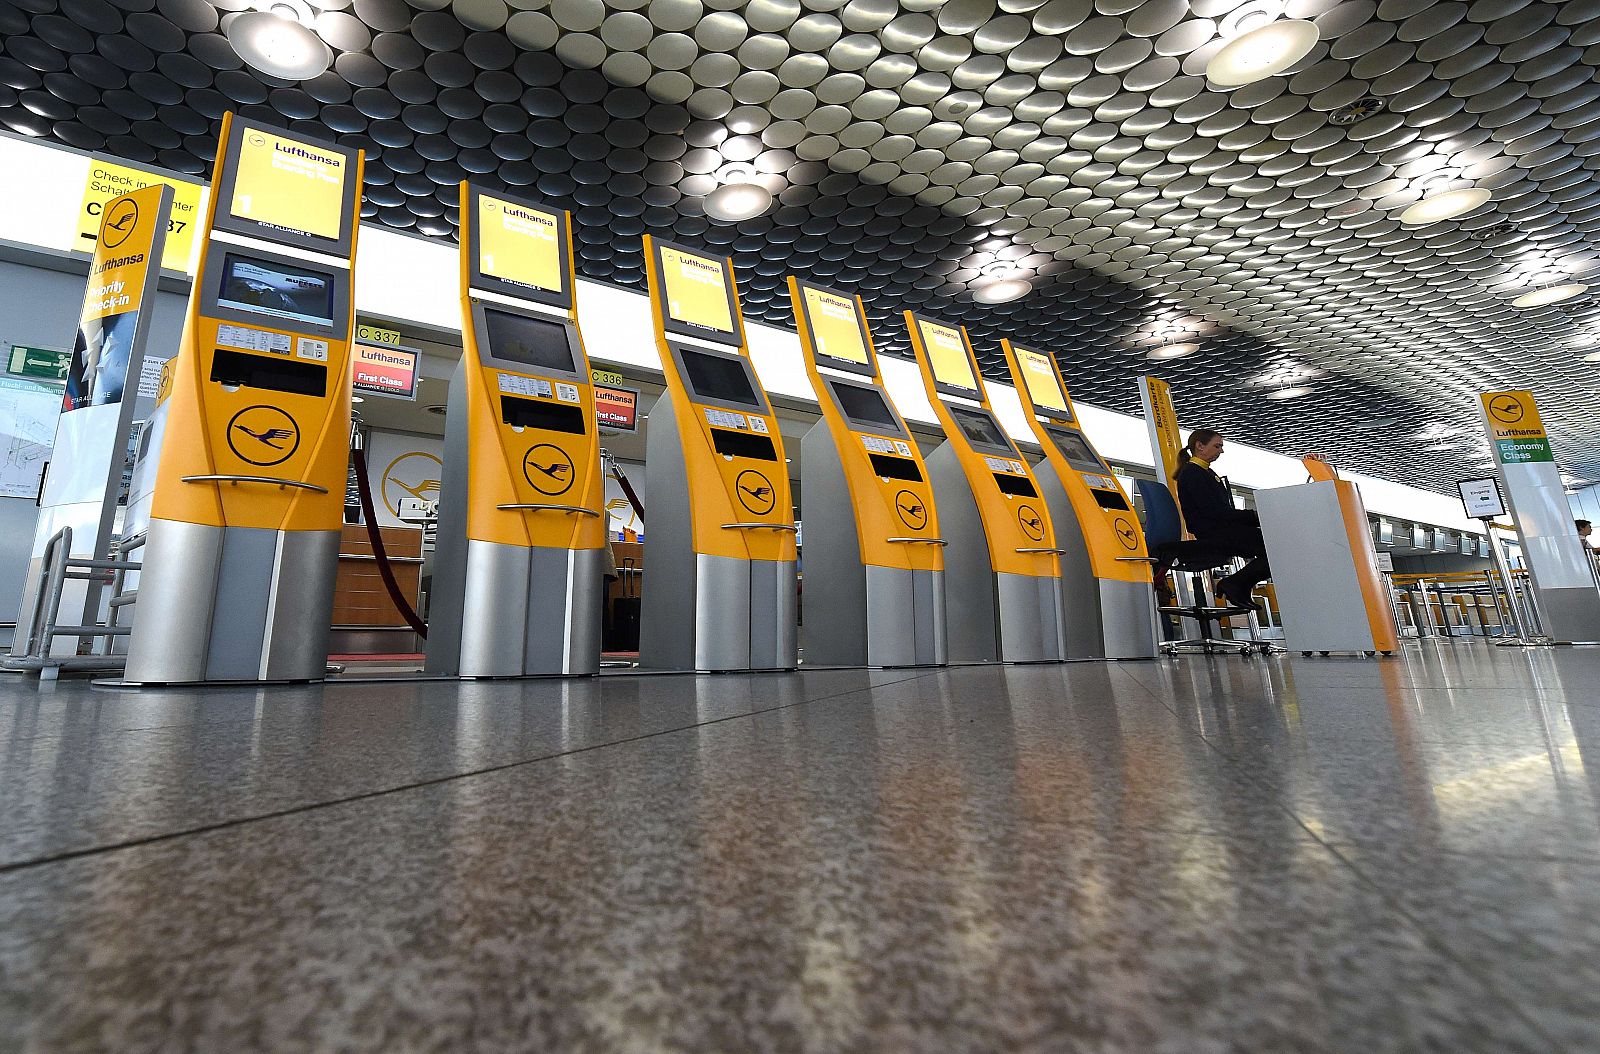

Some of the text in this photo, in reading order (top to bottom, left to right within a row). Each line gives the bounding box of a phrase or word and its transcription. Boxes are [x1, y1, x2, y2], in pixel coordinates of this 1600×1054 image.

[275, 142, 341, 168] Lufthansa
[93, 169, 147, 188] Check in
[86, 202, 102, 216] C
[503, 205, 554, 227] Lufthansa
[274, 225, 305, 236] ALLIANCE
[93, 253, 144, 275] Lufthansa
[679, 256, 721, 274] Lufthansa
[90, 293, 130, 312] heck-in
[359, 328, 399, 344] C 337
[361, 350, 411, 366] Lufthansa
[357, 372, 404, 387] First Class
[592, 371, 622, 386] C 336
[83, 390, 112, 401] ALLCE
[595, 390, 633, 405] Lufthansa
[1149, 382, 1163, 429] Bordkarte
[609, 413, 628, 422] Class
[1496, 428, 1542, 437] Lufthansa
[1500, 443, 1544, 451] Economy
[1503, 452, 1532, 460] Class
